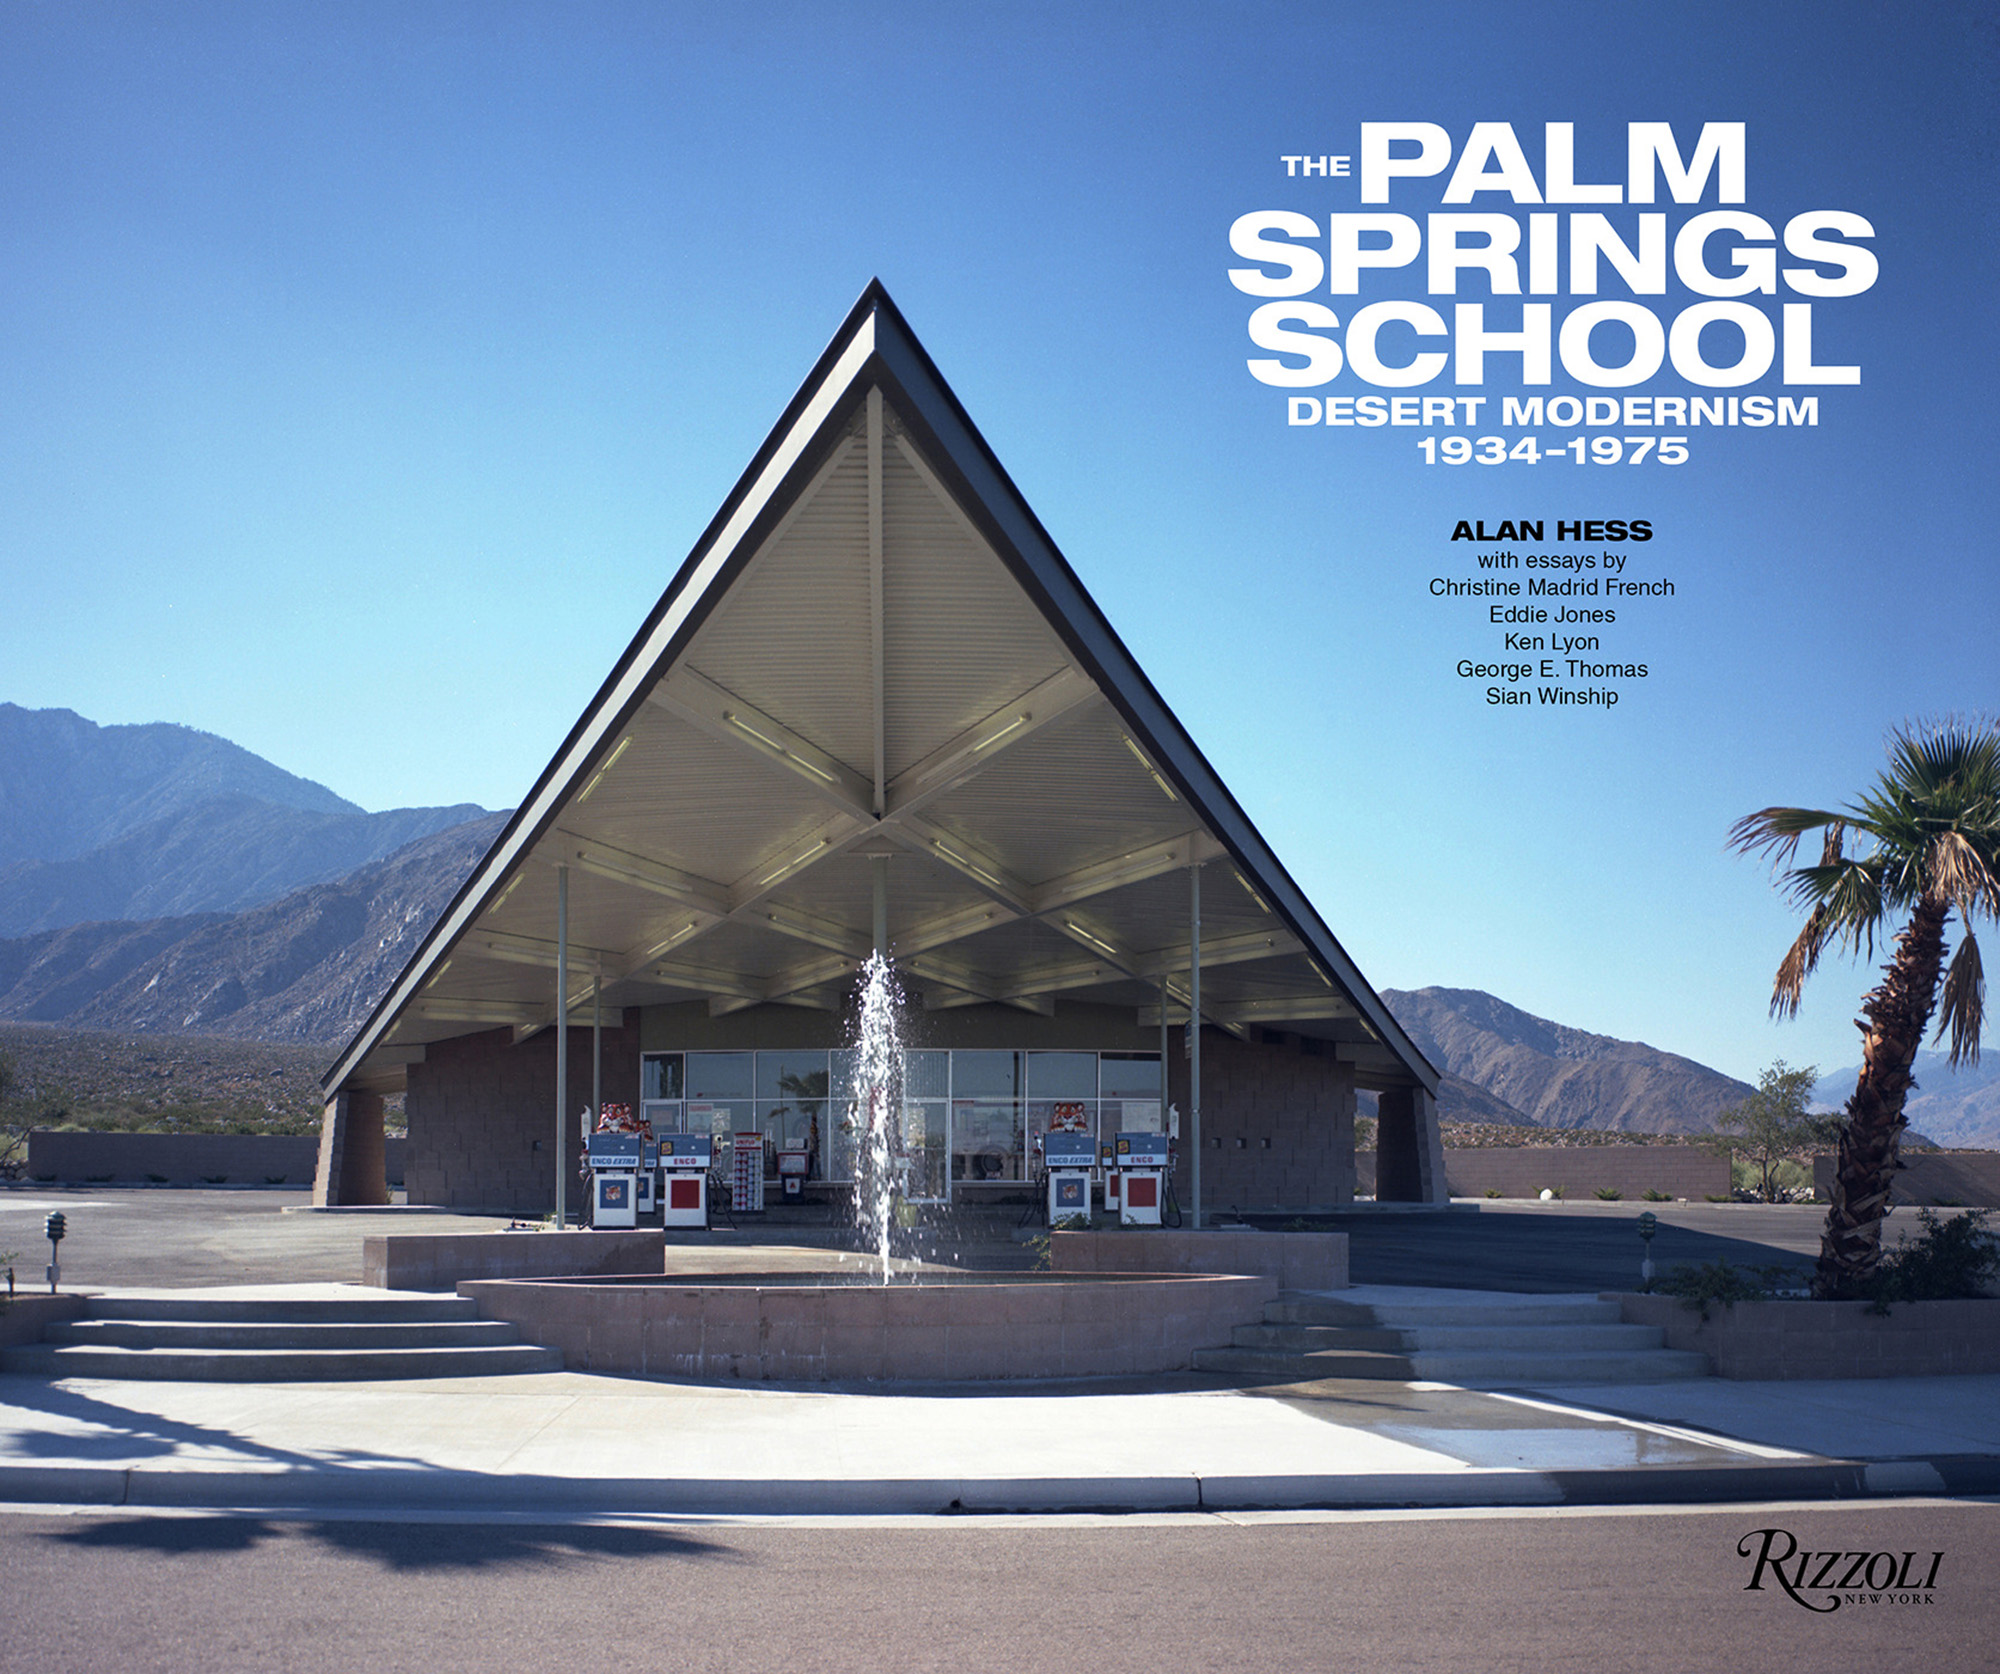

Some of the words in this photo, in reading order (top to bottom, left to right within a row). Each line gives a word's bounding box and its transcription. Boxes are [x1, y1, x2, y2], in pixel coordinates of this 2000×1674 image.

[591, 1157, 612, 1165] ENCO
[613, 1157, 637, 1165] EXTRA
[1048, 1156, 1068, 1164] ENCO
[1069, 1156, 1093, 1164] EXTRA
[1130, 1156, 1154, 1164] ENCO
